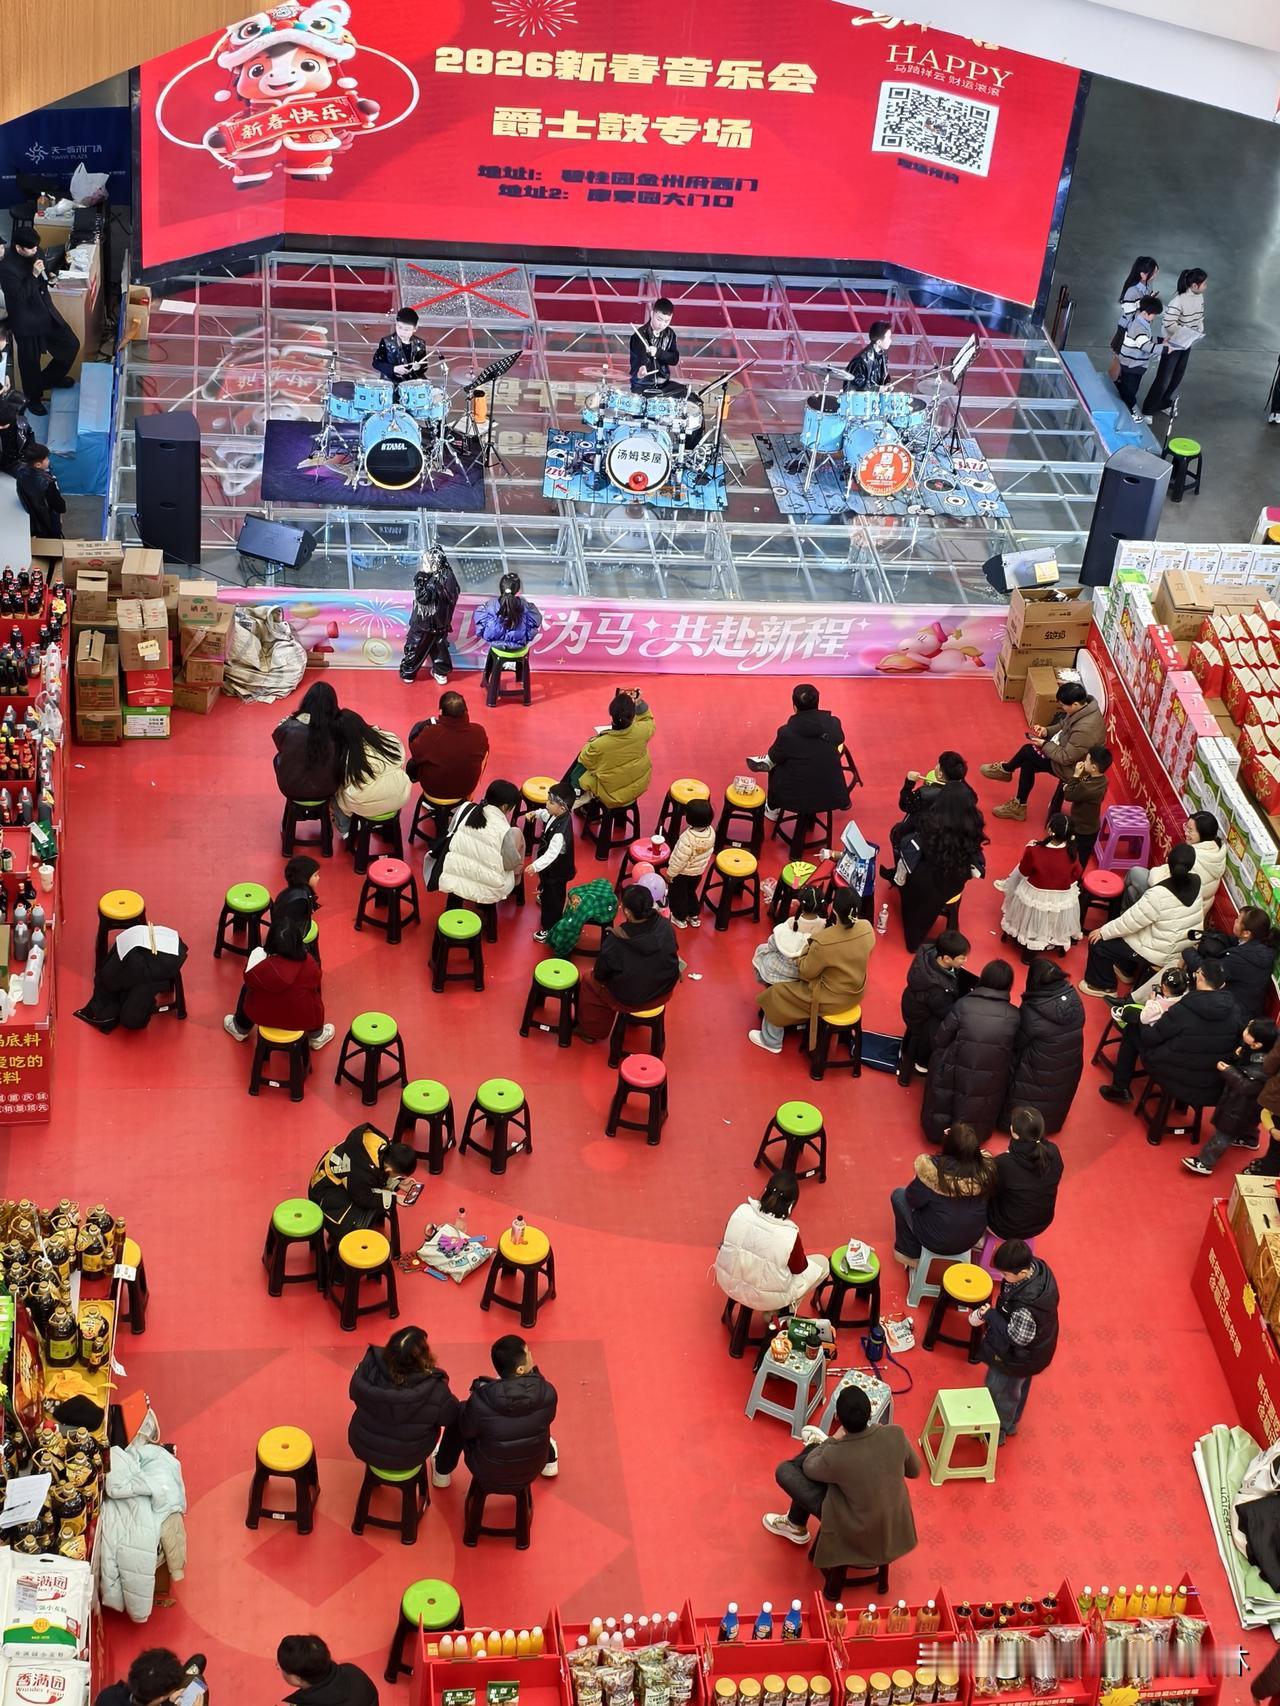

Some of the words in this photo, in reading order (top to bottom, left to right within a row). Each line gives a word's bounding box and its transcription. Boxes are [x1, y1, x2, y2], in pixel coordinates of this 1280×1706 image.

[434, 46, 818, 93] 2026新春音乐会
[886, 44, 1013, 89] HAPPY
[241, 103, 347, 139] 新春快乐
[492, 106, 754, 148] 爵士鼓专场
[617, 448, 663, 465] 汤姆琴屋
[638, 614, 857, 672] 共赴新程
[0, 1033, 42, 1048] 底料
[0, 1071, 21, 1085] 料
[16, 1672, 66, 1692] 香满园
